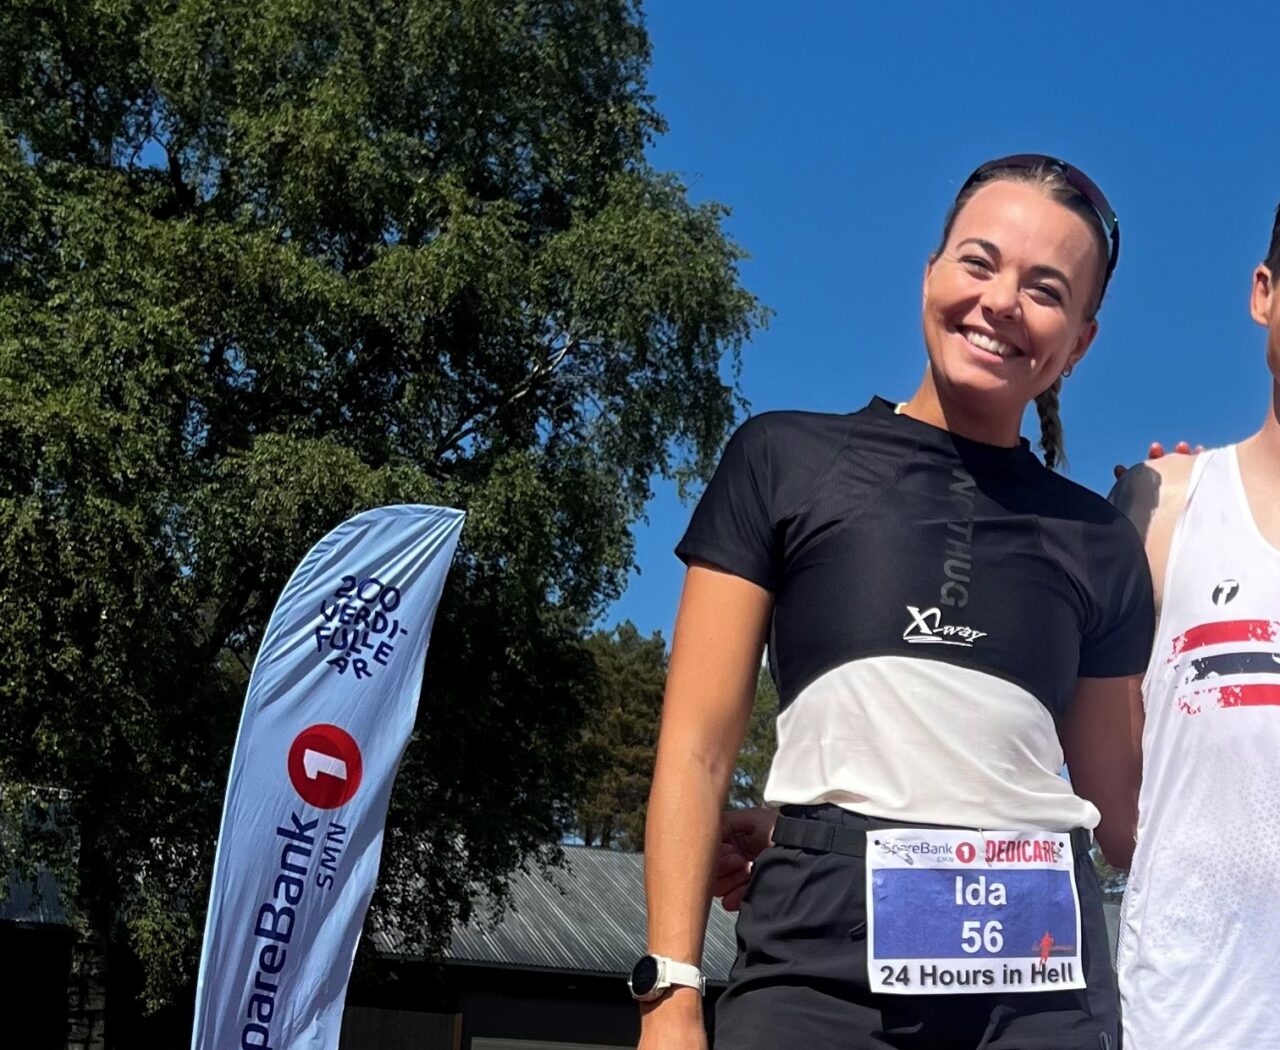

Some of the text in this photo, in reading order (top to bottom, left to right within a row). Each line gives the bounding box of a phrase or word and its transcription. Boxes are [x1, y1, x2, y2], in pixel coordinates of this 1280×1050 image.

[334, 575, 401, 613] 200
[320, 600, 408, 638] VERDI-
[315, 626, 394, 666] FULLE
[327, 651, 373, 680] ÅR
[303, 748, 348, 781] 1
[316, 821, 347, 891] SMN
[985, 839, 1058, 863] DEDICARE
[955, 875, 1008, 906] Ida
[960, 920, 1005, 954] 56
[880, 962, 1074, 987] 24 Hours in Hell
